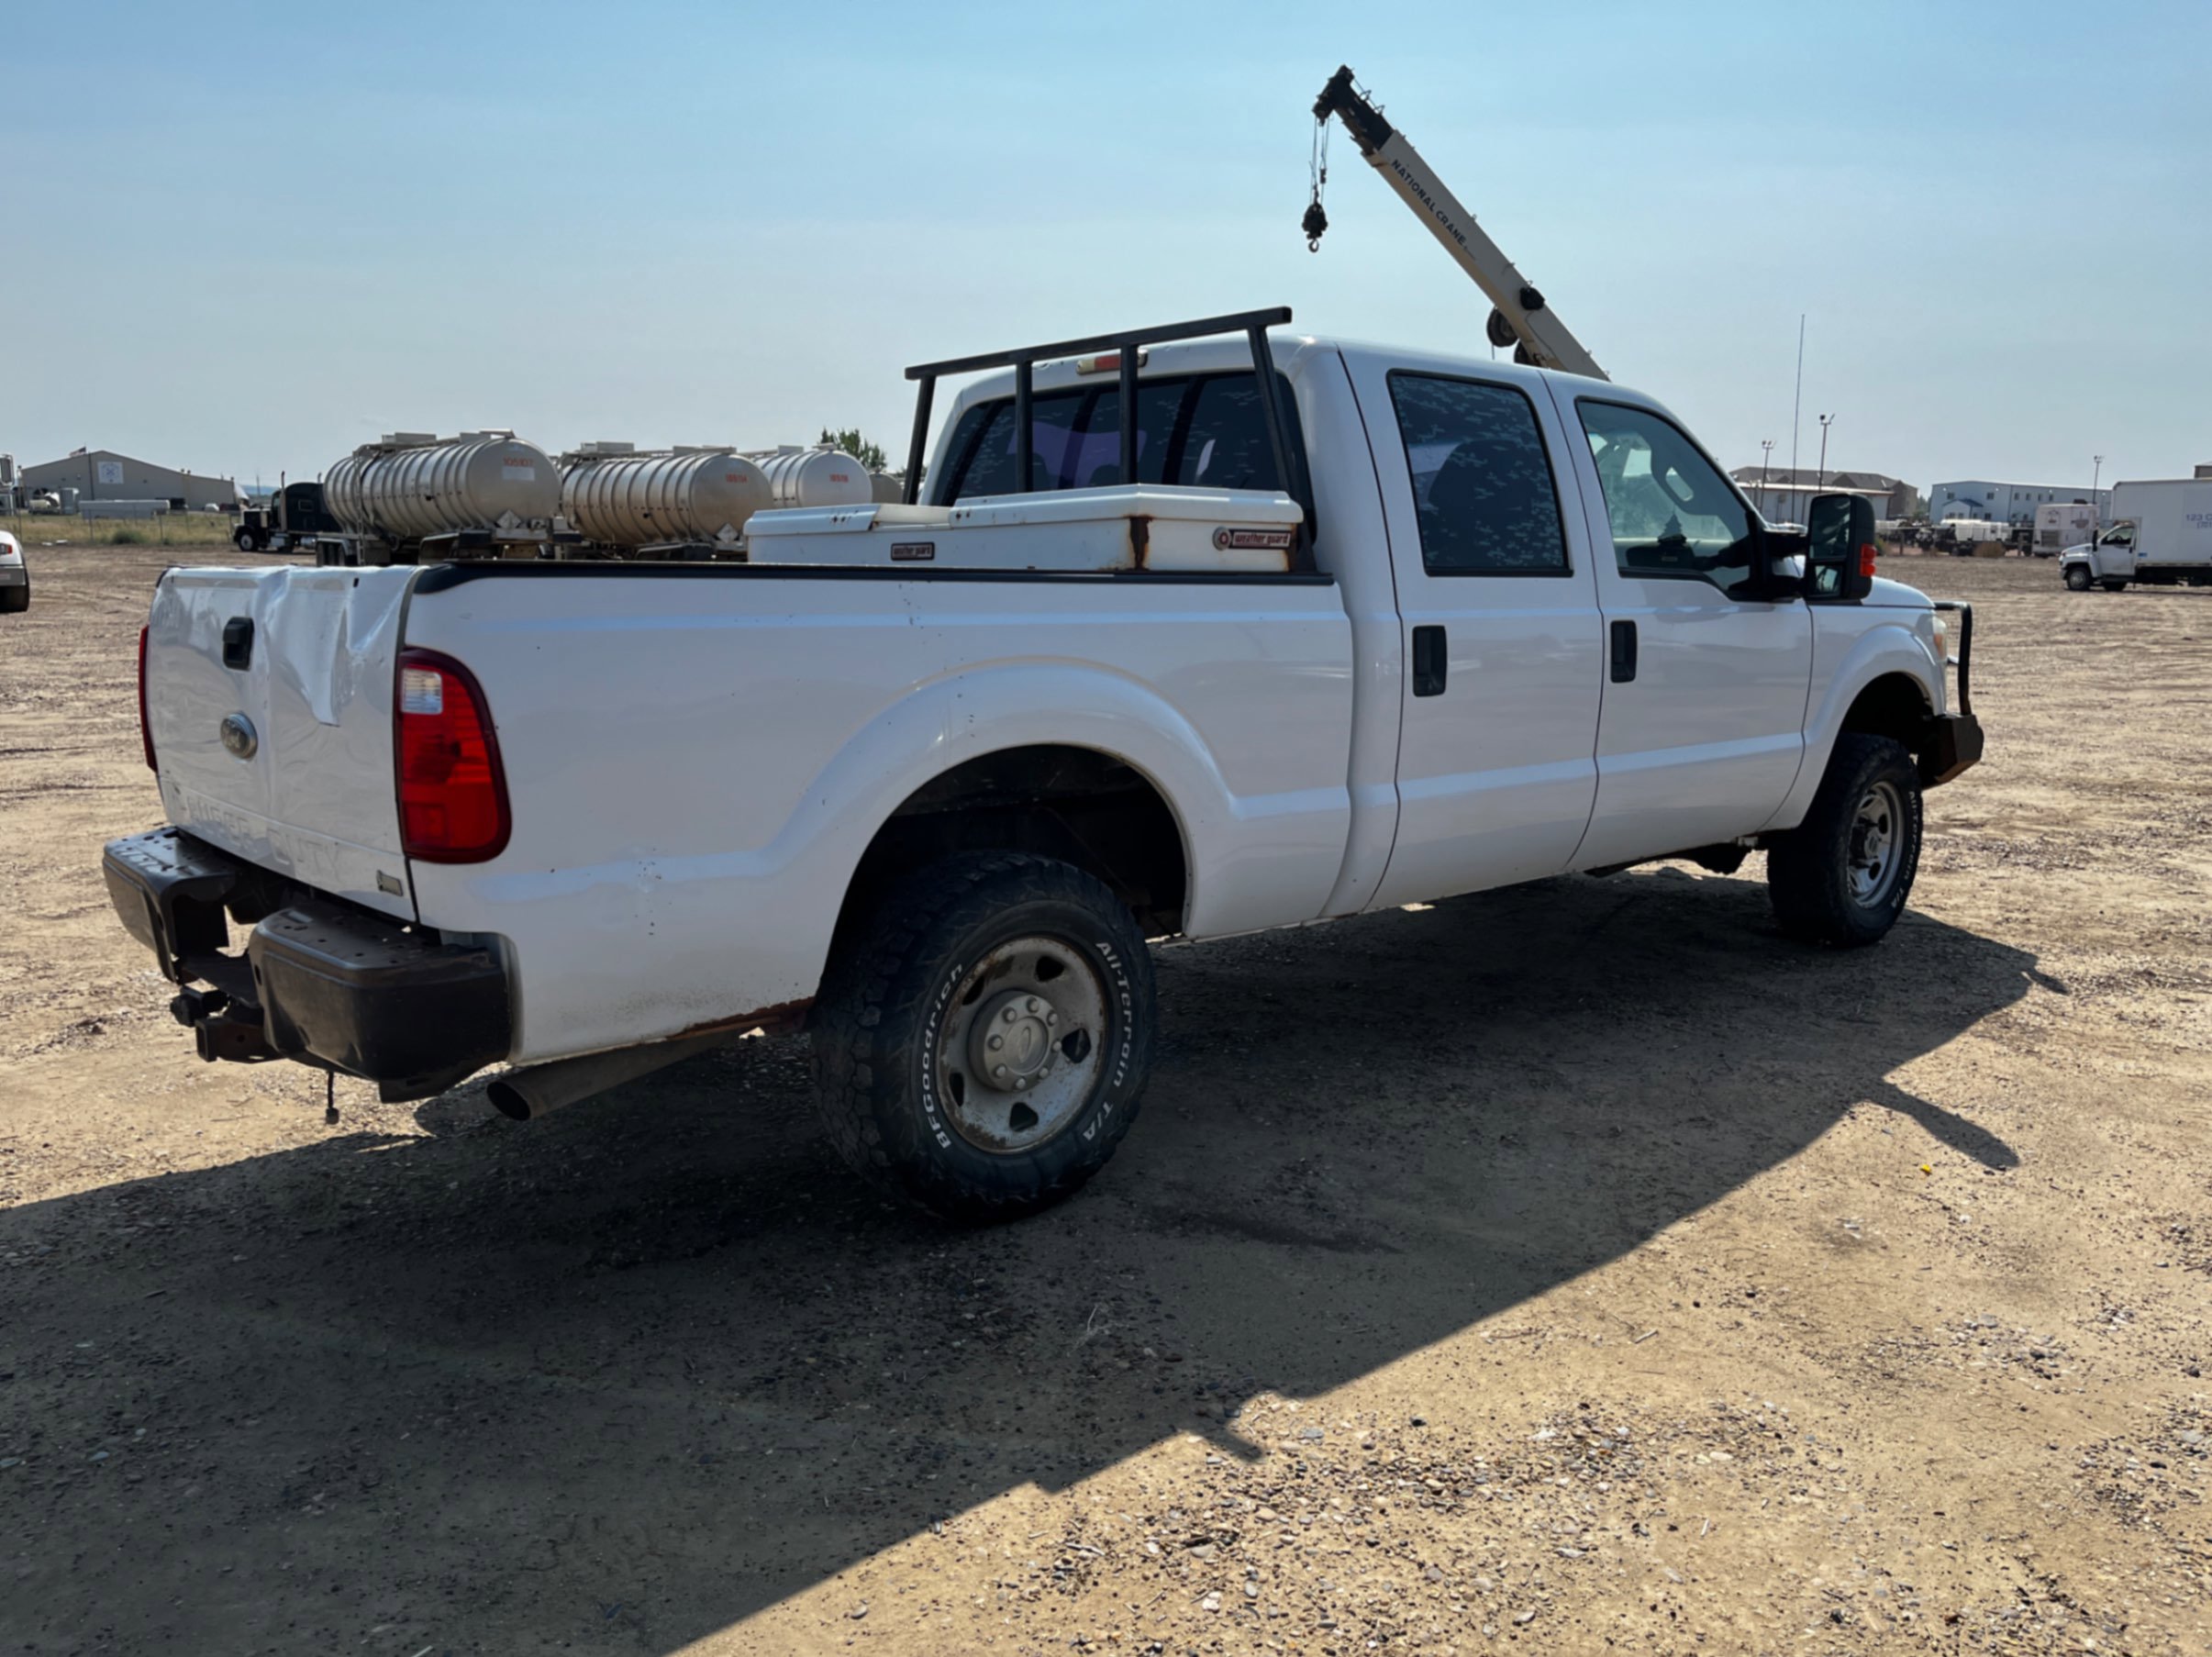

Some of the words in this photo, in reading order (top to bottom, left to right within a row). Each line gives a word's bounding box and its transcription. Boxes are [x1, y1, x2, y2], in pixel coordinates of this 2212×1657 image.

[1391, 159, 1436, 212] NATIONAL
[1435, 210, 1467, 246] CRANE
[922, 963, 963, 1149] BFGoodrich
[1095, 941, 1133, 1088] All-Terrain
[1083, 1101, 1114, 1141] T/A
